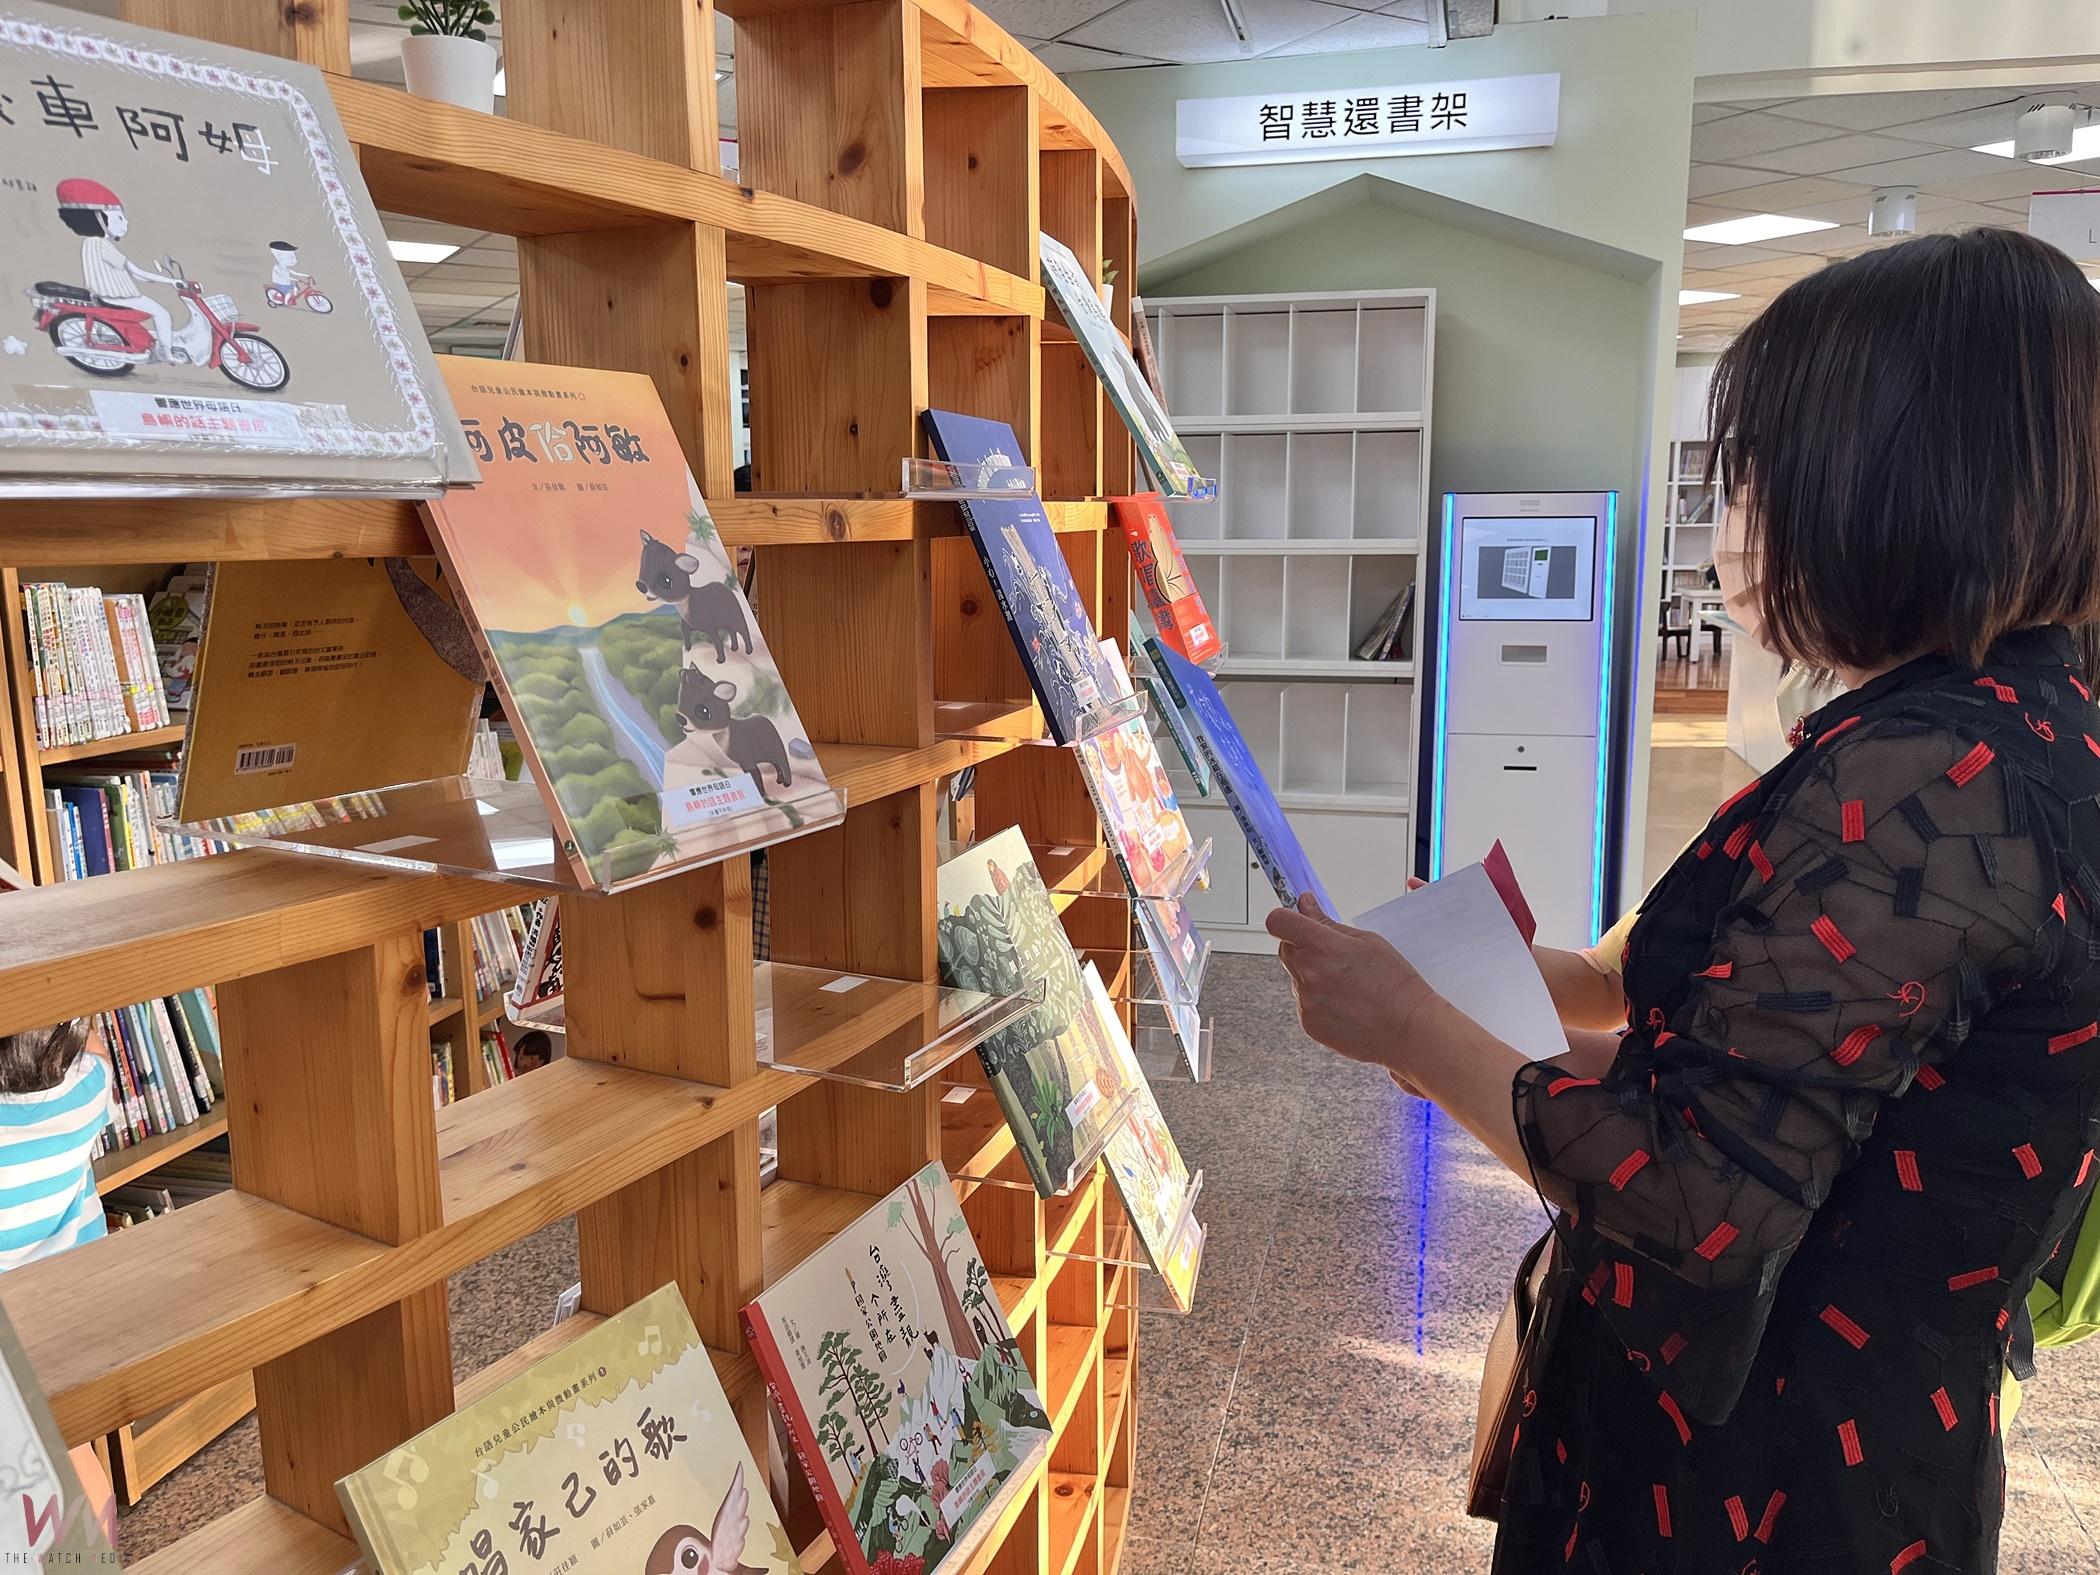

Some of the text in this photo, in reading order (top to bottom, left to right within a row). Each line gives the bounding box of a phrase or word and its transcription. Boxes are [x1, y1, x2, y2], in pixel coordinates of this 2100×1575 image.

[0, 74, 279, 175] 車阿姆
[1259, 92, 1468, 142] 智慧還書架
[855, 1294, 887, 1363] 國家公園地圖
[474, 1371, 598, 1458] 台語兒童公民繪本與微動畫系列
